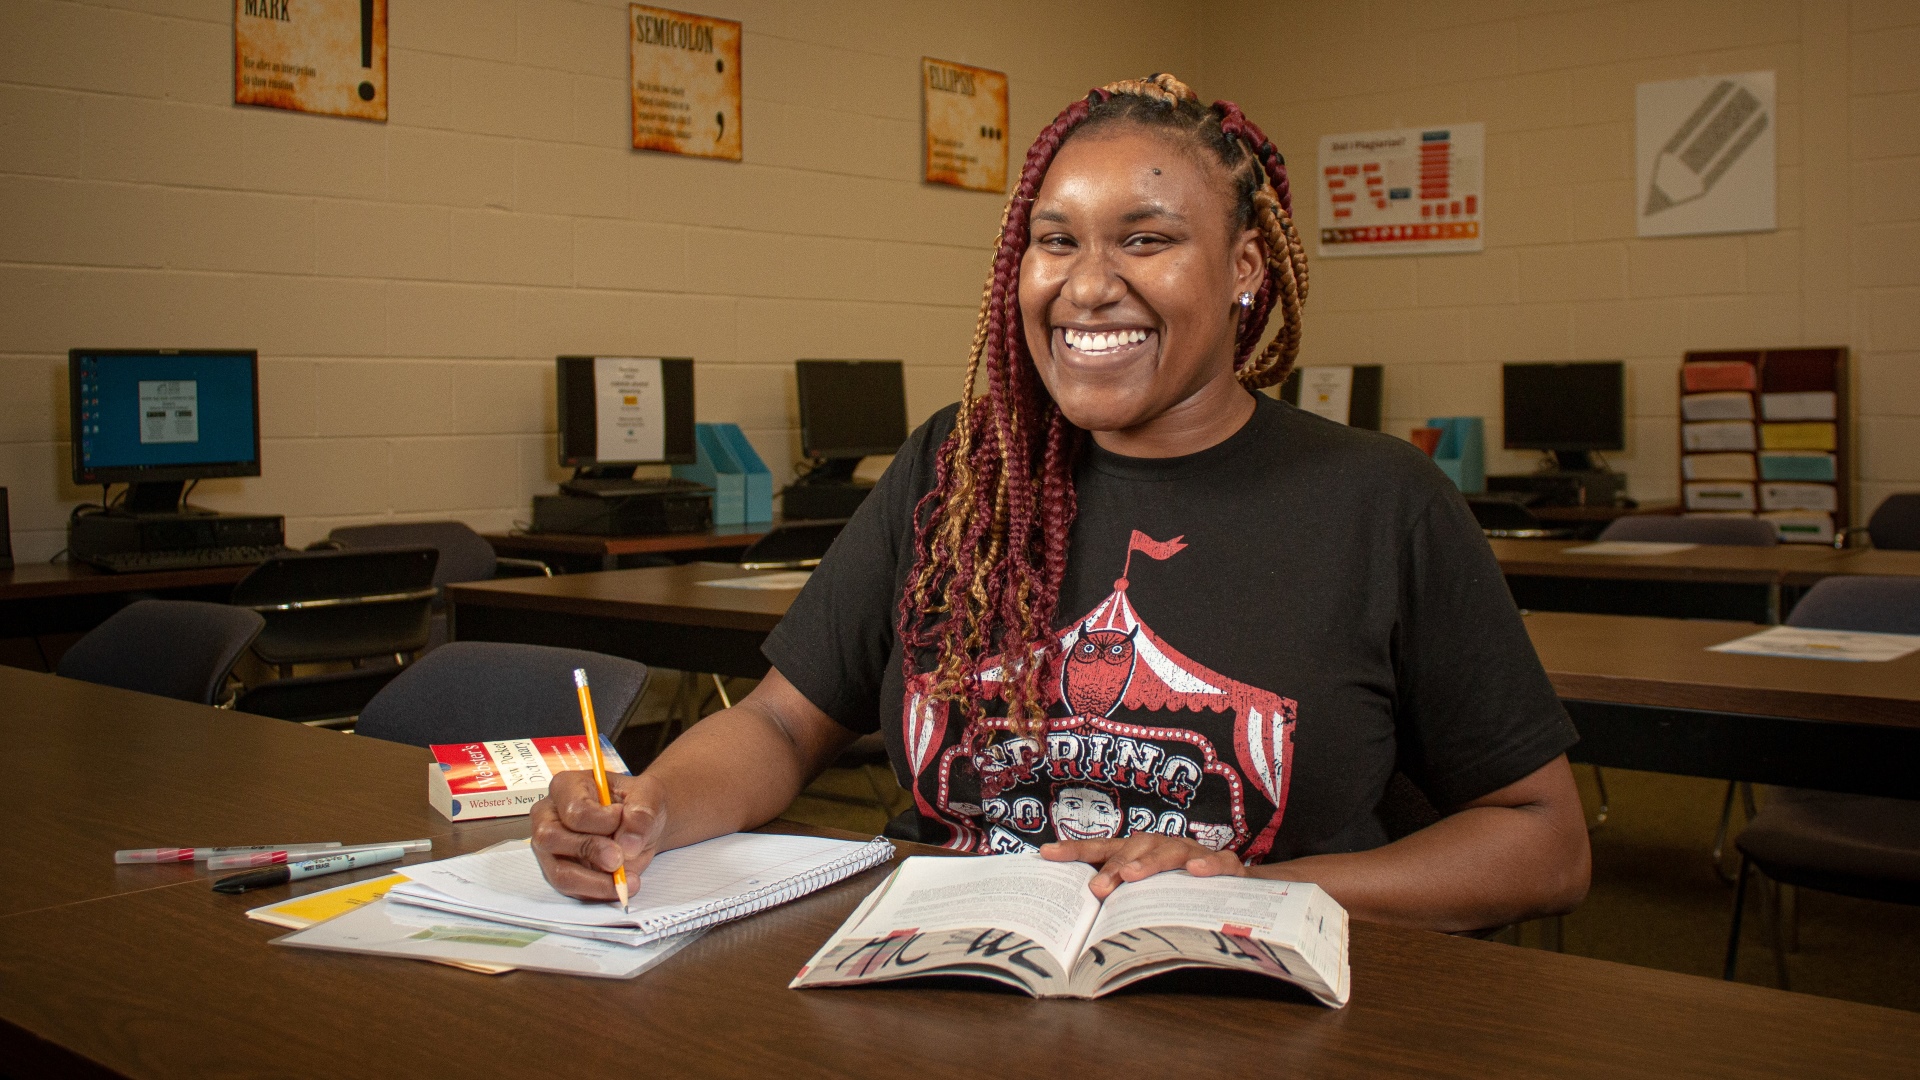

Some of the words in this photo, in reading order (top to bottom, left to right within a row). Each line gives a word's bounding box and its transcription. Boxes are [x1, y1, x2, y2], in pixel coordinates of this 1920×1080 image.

[245, 0, 290, 22] MARK
[636, 14, 714, 53] SEMICOLON
[462, 744, 500, 788] Webster's
[493, 742, 516, 768] Pocket
[512, 741, 548, 784] Dictionary
[974, 731, 1202, 810] SPRING
[508, 767, 524, 787] New
[469, 797, 512, 808] Webster's
[514, 795, 536, 804] New
[982, 797, 1048, 833] 20
[1124, 806, 1188, 838] 20
